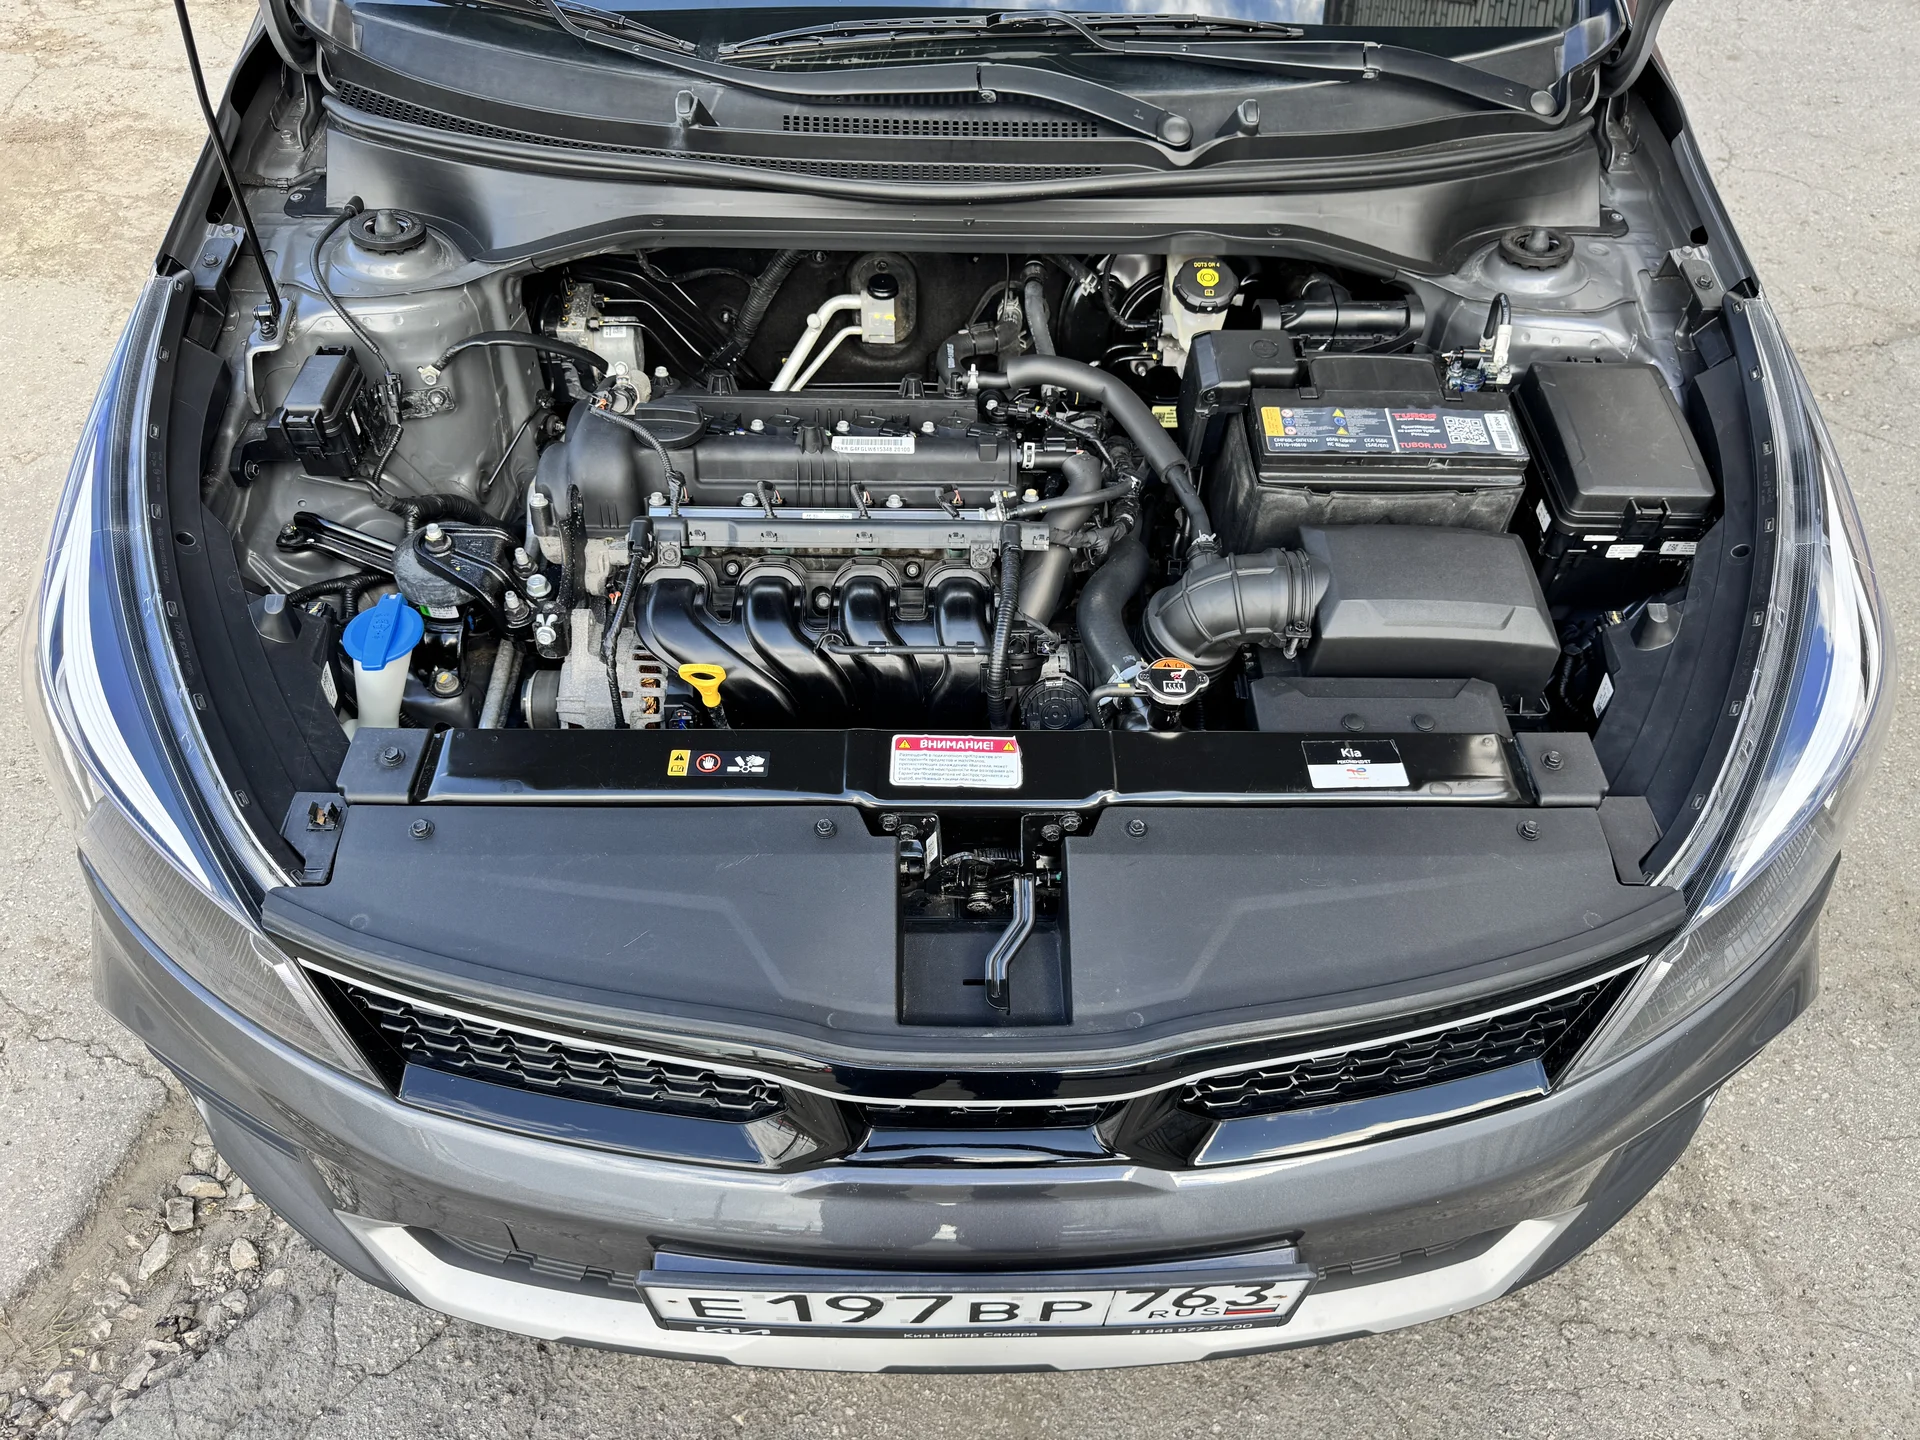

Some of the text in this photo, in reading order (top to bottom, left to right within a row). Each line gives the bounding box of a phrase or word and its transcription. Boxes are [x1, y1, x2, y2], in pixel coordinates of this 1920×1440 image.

[920, 739, 994, 750] ВНИМАНИЕ!
[1340, 748, 1362, 757] Kia
[1126, 1283, 1276, 1312] 763
[1148, 1306, 1220, 1319] RUS
